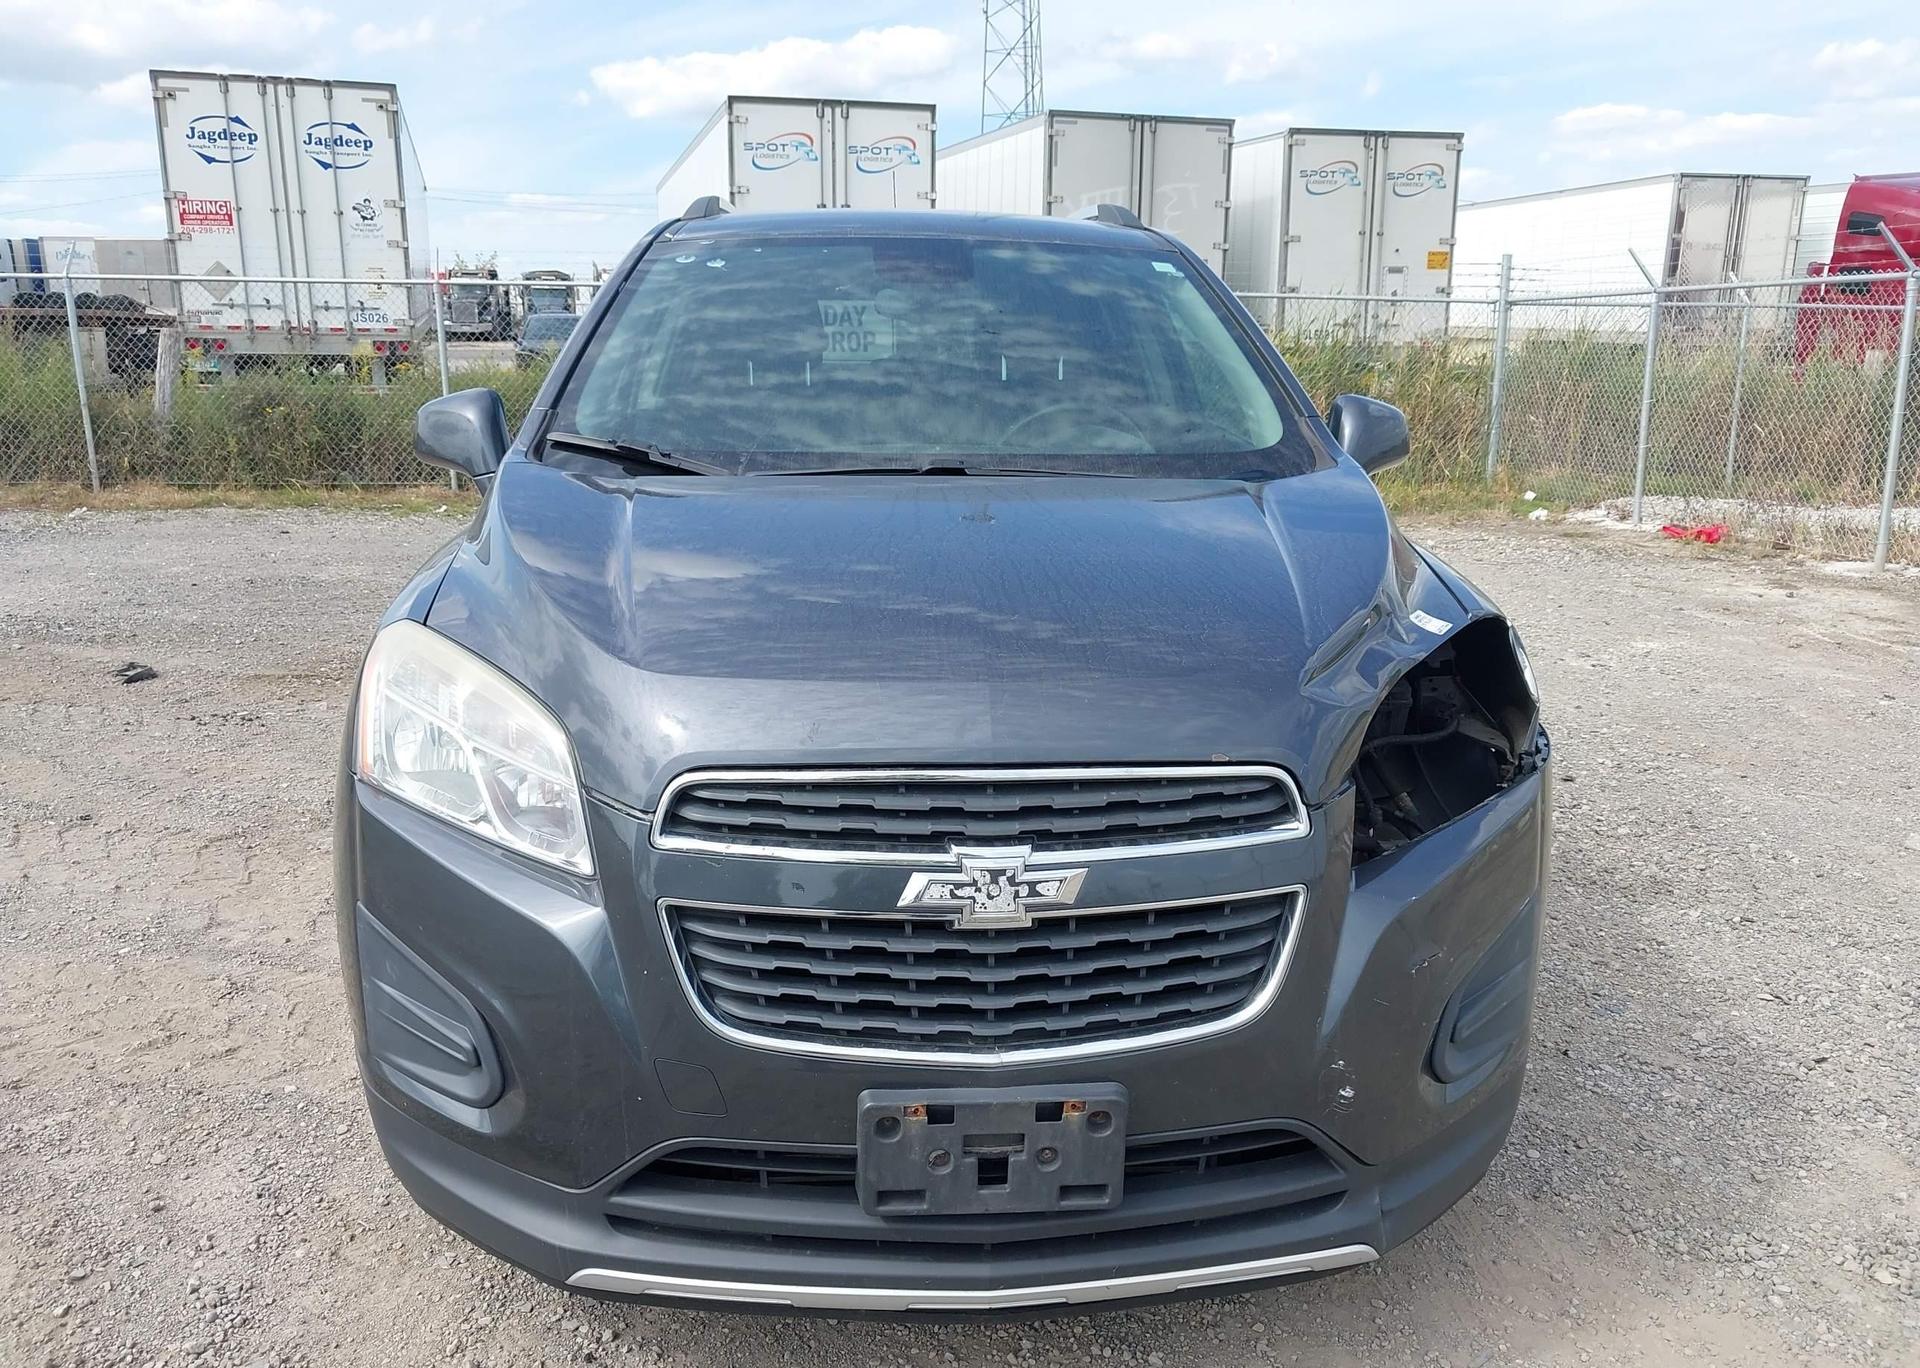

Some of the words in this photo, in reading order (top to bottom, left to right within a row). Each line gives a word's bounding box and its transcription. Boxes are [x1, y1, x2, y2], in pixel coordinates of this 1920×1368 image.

[186, 126, 258, 145] Jagdeep
[303, 133, 373, 151] Jagdeep
[744, 142, 789, 152] SPOT
[848, 146, 892, 155] SPOT
[1300, 170, 1338, 178] SPOT
[1387, 172, 1425, 181] SPOT
[179, 200, 231, 214] HIRING!
[181, 226, 235, 234] 204-298-1721
[352, 312, 389, 323] JS026
[823, 305, 867, 327] DAY
[827, 331, 876, 352] ROP
